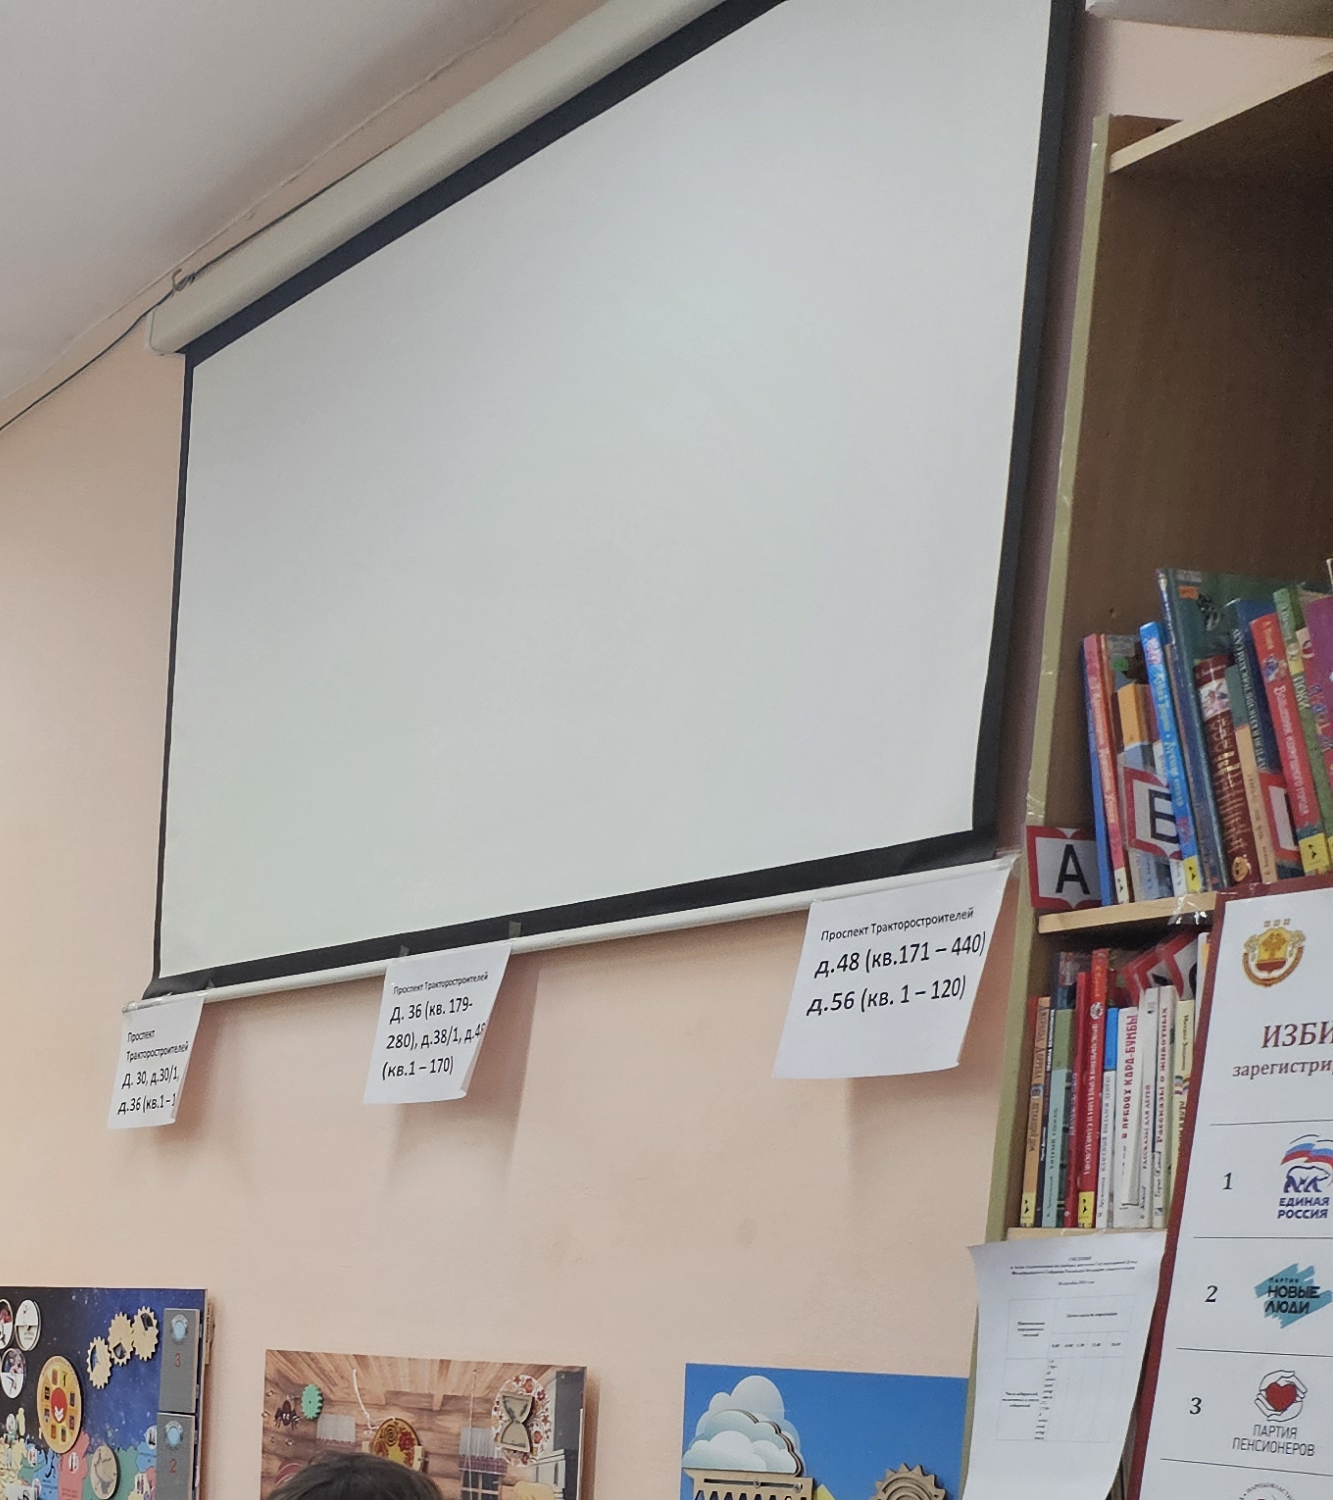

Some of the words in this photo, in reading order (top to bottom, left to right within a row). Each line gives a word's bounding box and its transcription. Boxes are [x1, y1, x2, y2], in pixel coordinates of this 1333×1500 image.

[1055, 844, 1091, 895] А
[821, 923, 869, 942] Проспект
[871, 906, 974, 934] Тракторостроителей
[814, 952, 860, 979] д.48
[866, 942, 930, 974] (кв.171
[951, 931, 986, 957] 440)
[393, 983, 424, 995] Проспект
[425, 971, 489, 991] Тракторостроителей
[806, 990, 855, 1016] д.56
[861, 988, 894, 1013] (кв.
[900, 984, 910, 1003] 1
[930, 975, 967, 1001] 120)
[389, 1006, 405, 1025] Д.
[408, 1003, 422, 1020] 36
[425, 1001, 446, 1020] (кв.
[127, 1030, 156, 1043] Проспект
[386, 1031, 418, 1050] 280),
[421, 1026, 462, 1049] д.38/1,
[126, 1040, 189, 1062] Тракторостроителей
[137, 1070, 148, 1086] 30,
[150, 1064, 180, 1087] д.30/1,
[382, 1061, 416, 1081] (кв.1
[429, 1055, 454, 1075] 170)
[1233, 1060, 1333, 1080] зарегистри
[117, 1096, 142, 1116] д.36
[1156, 1086, 1166, 1143] Рассказы
[1222, 1172, 1233, 1190] 1
[1279, 1196, 1330, 1208] ЕДИНАЯ
[1277, 1208, 1328, 1219] РОССИЯ
[1205, 1285, 1218, 1303] 2
[1268, 1285, 1320, 1299] НОВЫЕ
[1265, 1300, 1312, 1315] ЛЮДИ
[175, 1353, 181, 1367] 3
[1189, 1397, 1202, 1415] 3
[1253, 1424, 1298, 1440] ПАРТИЯ
[1232, 1437, 1315, 1457] ПЕНСИОНЕРОВ
[170, 1459, 177, 1474] 2
